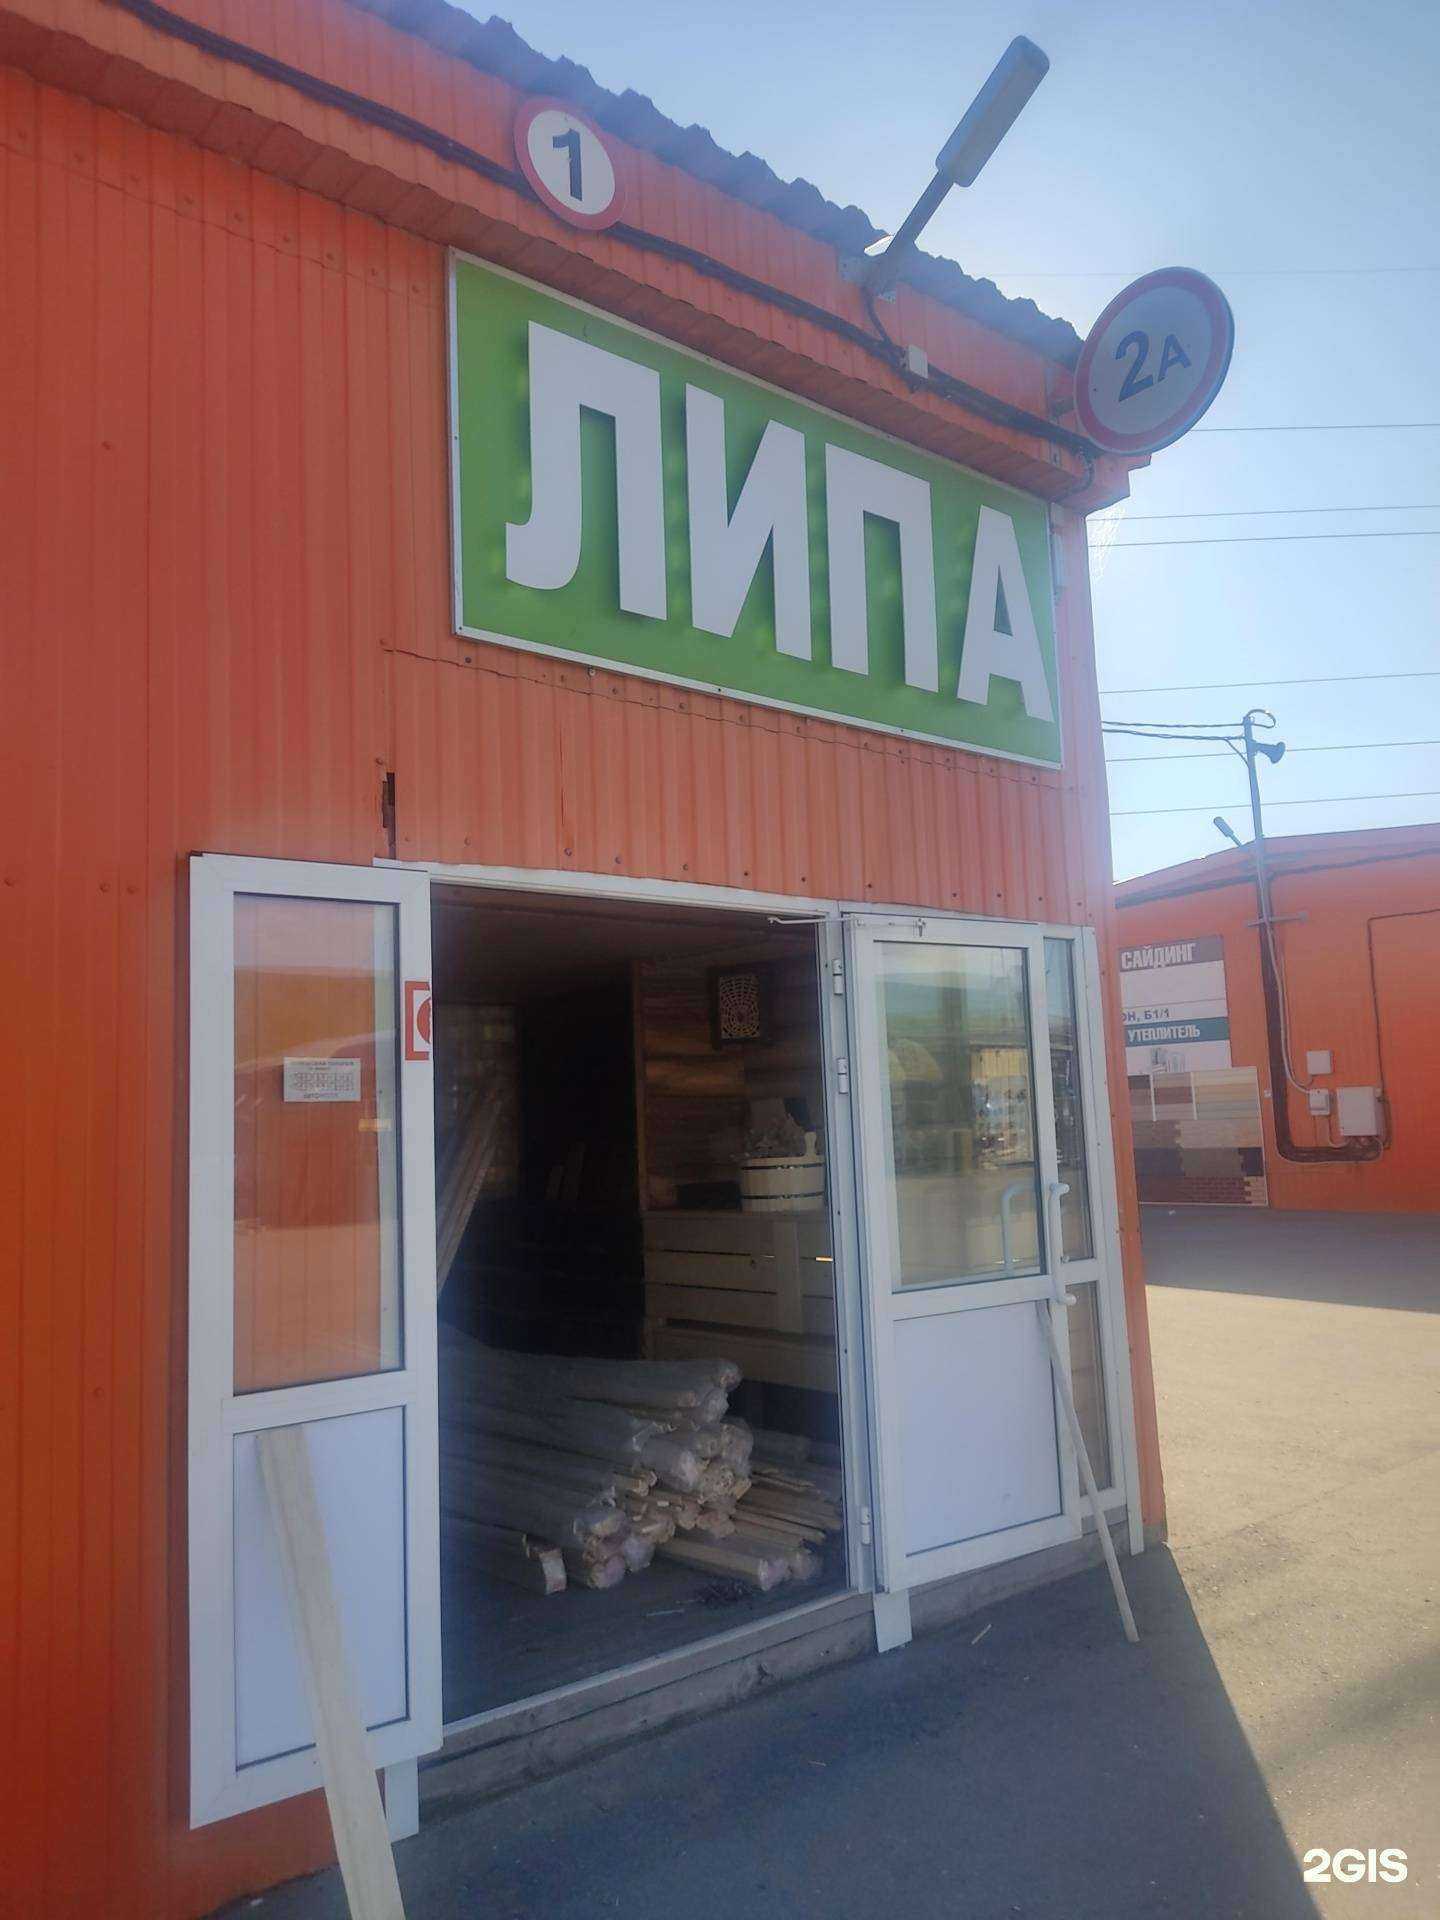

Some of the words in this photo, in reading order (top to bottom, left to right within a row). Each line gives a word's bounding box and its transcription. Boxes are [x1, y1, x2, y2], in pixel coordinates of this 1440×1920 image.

[552, 128, 582, 201] 1
[506, 321, 1054, 722] ЛИПА
[1121, 943, 1196, 969] САЙДИНГ
[1127, 1024, 1201, 1042] УТЕПЛИТЕЛЬ
